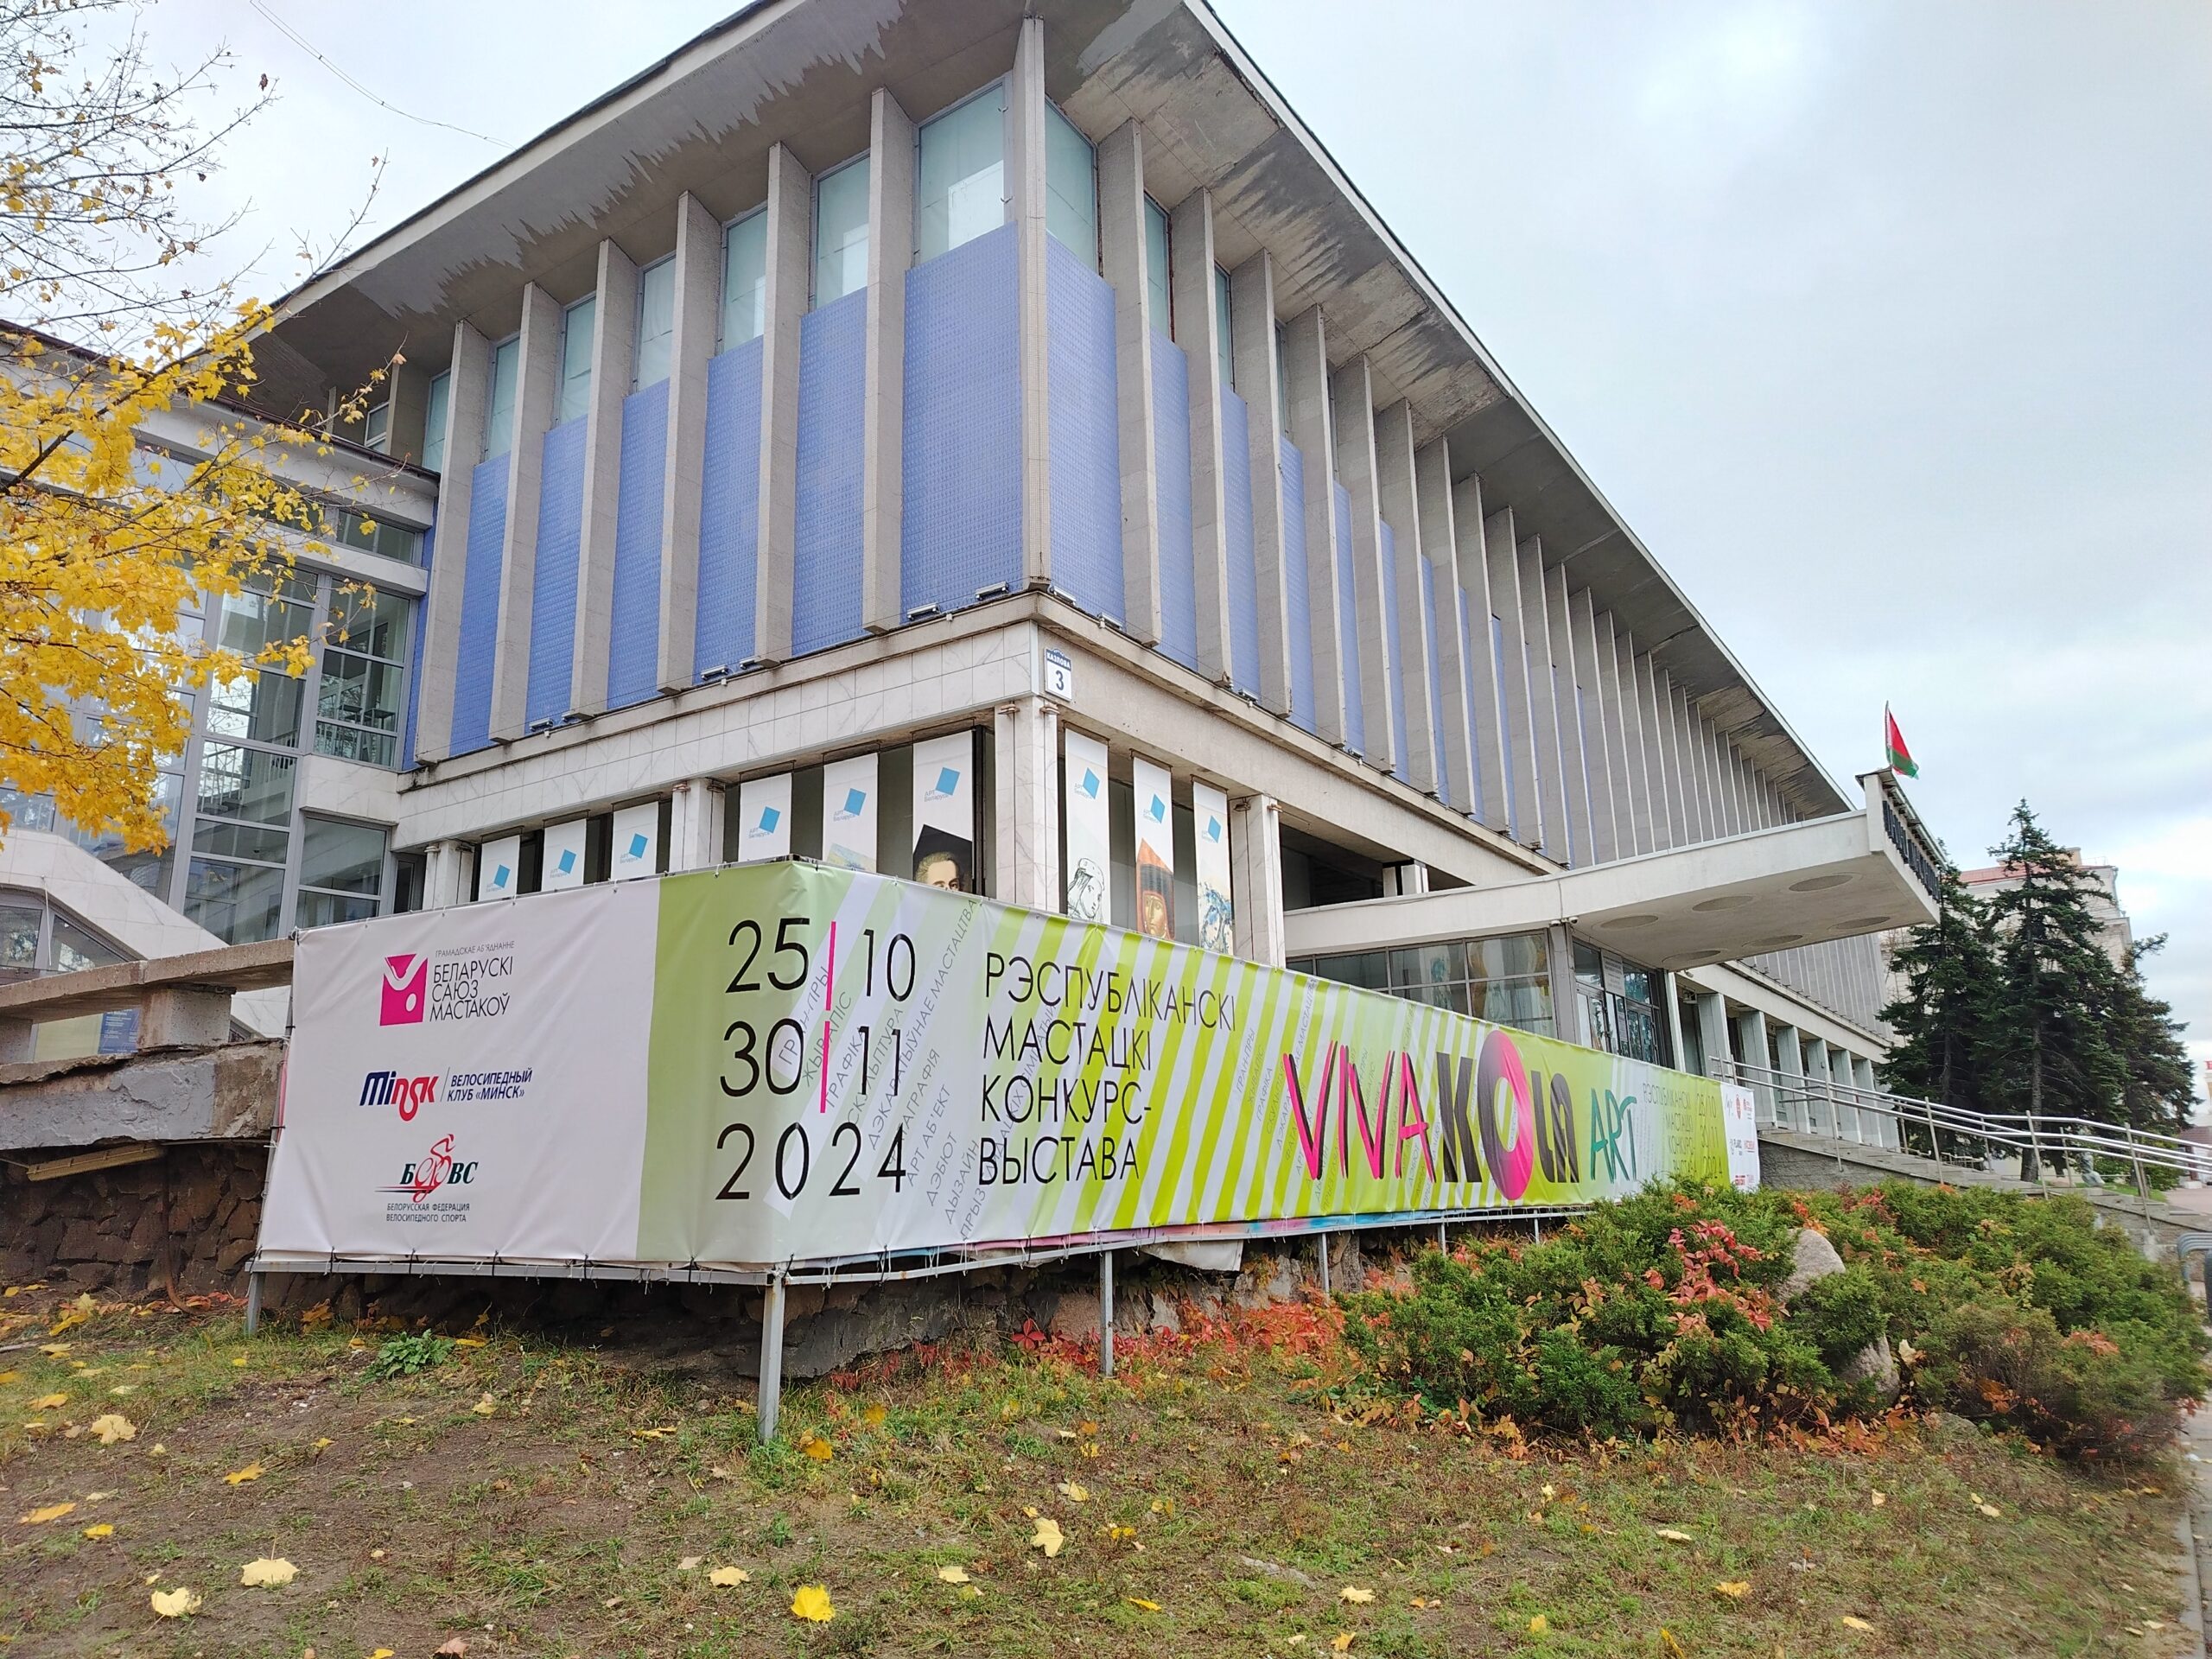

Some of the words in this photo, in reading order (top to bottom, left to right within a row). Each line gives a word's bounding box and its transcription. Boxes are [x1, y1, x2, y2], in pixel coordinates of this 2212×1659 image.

[1056, 671, 1064, 690] 3
[434, 957, 513, 983] БЕЛАРУСКІ
[435, 946, 475, 958] ГРАМАДСКАЕ
[931, 899, 976, 999] МАСТАЦТВА
[429, 992, 510, 1022] МАСТАКОЎ
[432, 979, 479, 1002] САЮЗ
[986, 952, 1236, 1032] РЭСПУБЛІКАНСКІ
[983, 1013, 1151, 1074] МАСТАЦКІ
[1236, 1028, 1255, 1093] ГРАН-ПРЫ
[447, 1089, 474, 1102] КЛУБ
[451, 1068, 533, 1087] ВЕЛОСИПЕДНЫЙ
[982, 1074, 1152, 1123] КОНКУРС-
[1255, 1068, 1273, 1122] ГРАФІКА
[907, 1147, 925, 1186] АРТ
[923, 1084, 950, 1148] АБ'ЕКТ
[1591, 1088, 1637, 1185] ART
[715, 1122, 906, 1200] 2024
[926, 1131, 957, 1206] ДЭБЮТ
[944, 1141, 979, 1224] ДЫЗАЙН
[979, 1136, 1139, 1185] ВЫСТАВА
[1703, 1155, 1723, 1179] 2024
[386, 1213, 438, 1222] ВЕЛОСИПЕДНОГО
[432, 1203, 470, 1211] ФЕДЕРАЦИЯ
[960, 1187, 986, 1240] ПРЫЗ
